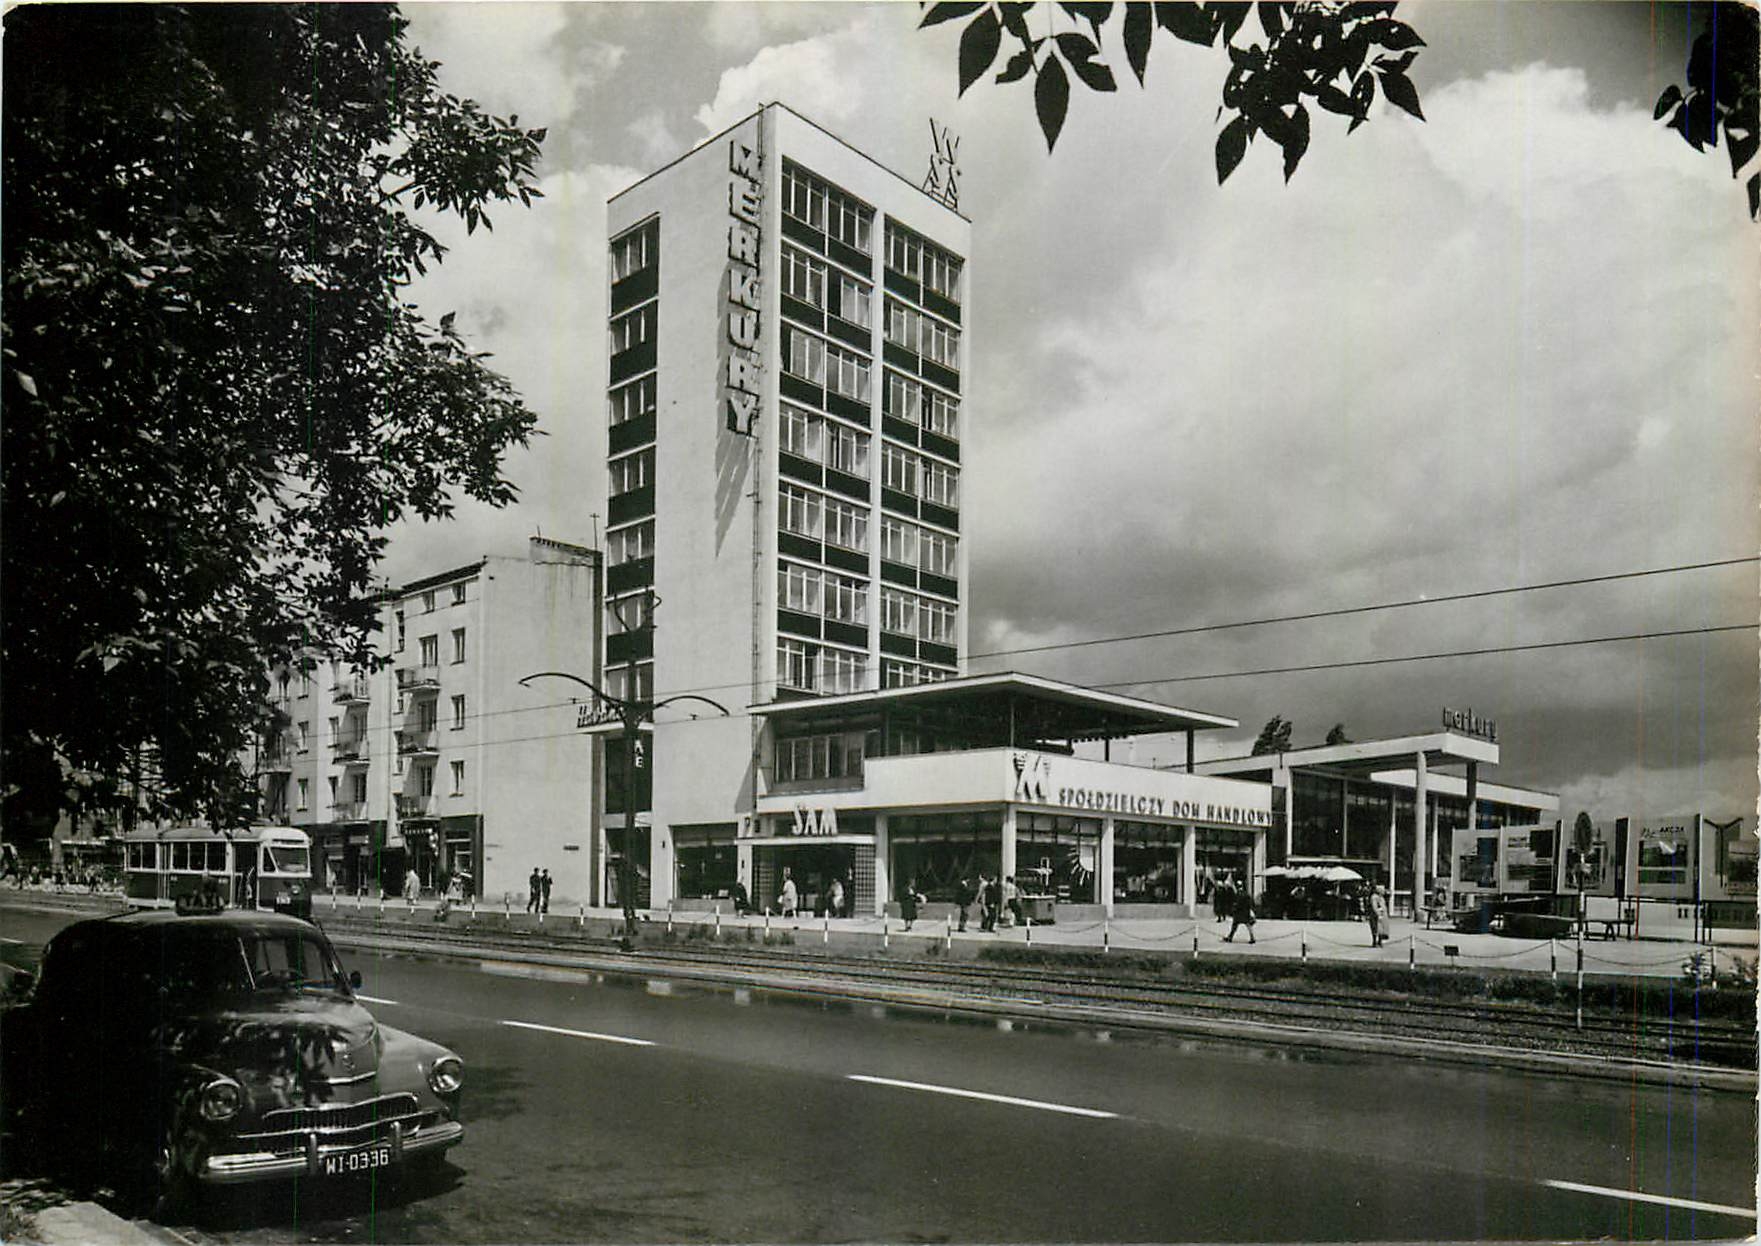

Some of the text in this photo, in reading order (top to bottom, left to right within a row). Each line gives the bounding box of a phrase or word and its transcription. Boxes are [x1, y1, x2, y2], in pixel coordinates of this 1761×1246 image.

[727, 139, 761, 439] MERKURY
[791, 802, 838, 836] SAM
[1059, 786, 1271, 825] SPÓŁDZIELCZY DOM HANDLOWY
